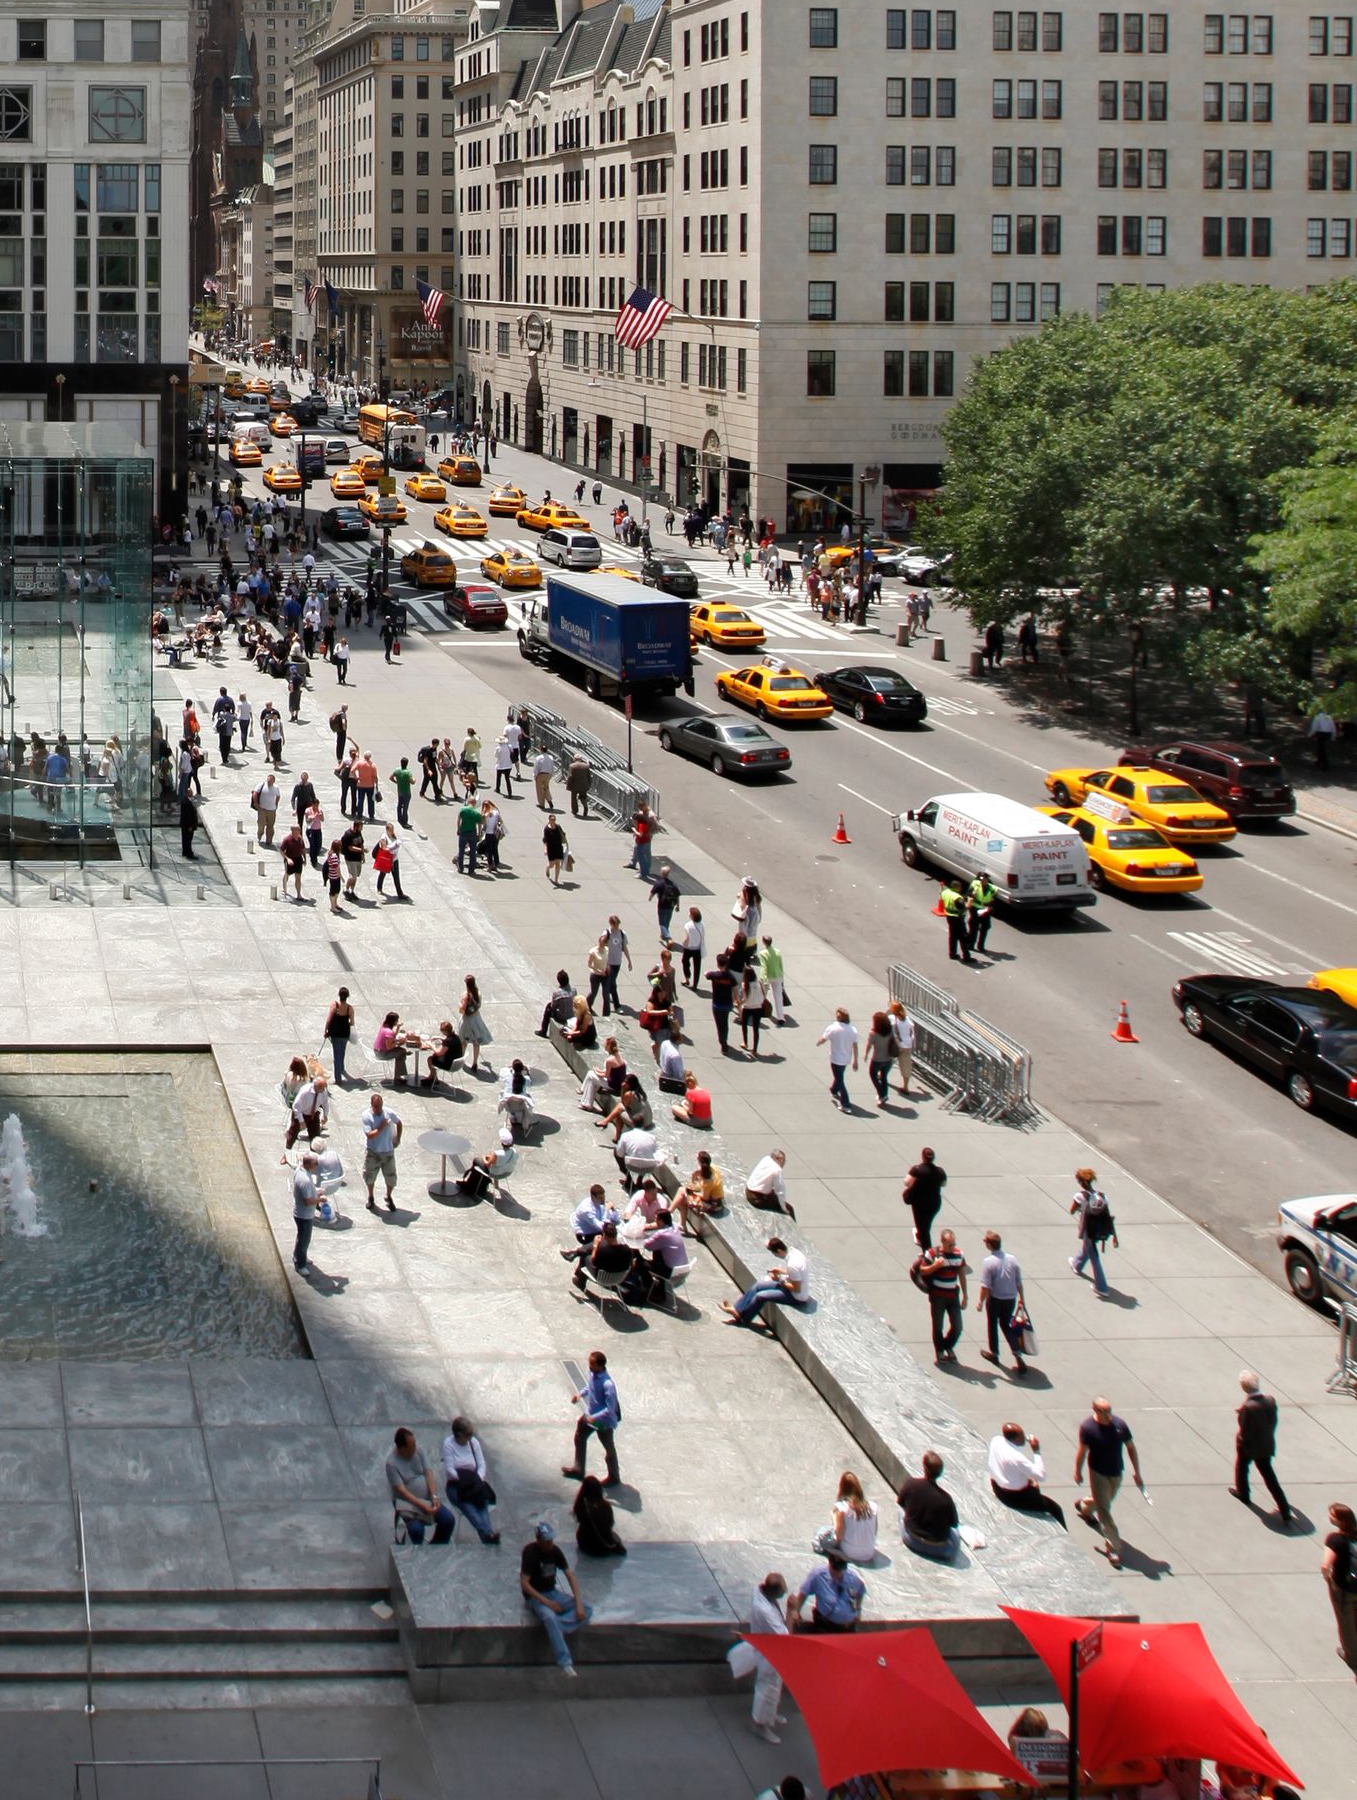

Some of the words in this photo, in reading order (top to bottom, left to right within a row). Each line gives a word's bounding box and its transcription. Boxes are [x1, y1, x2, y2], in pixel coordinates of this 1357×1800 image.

[401, 327, 444, 343] Kapoor
[560, 616, 590, 641] BROADWAY
[637, 642, 672, 650] BROADWAY
[943, 810, 991, 838] MERIT-KAPLAN
[948, 825, 979, 847] PAINT
[1022, 840, 1075, 849] MERIT-KAPLAN
[1032, 851, 1069, 861] PAINT
